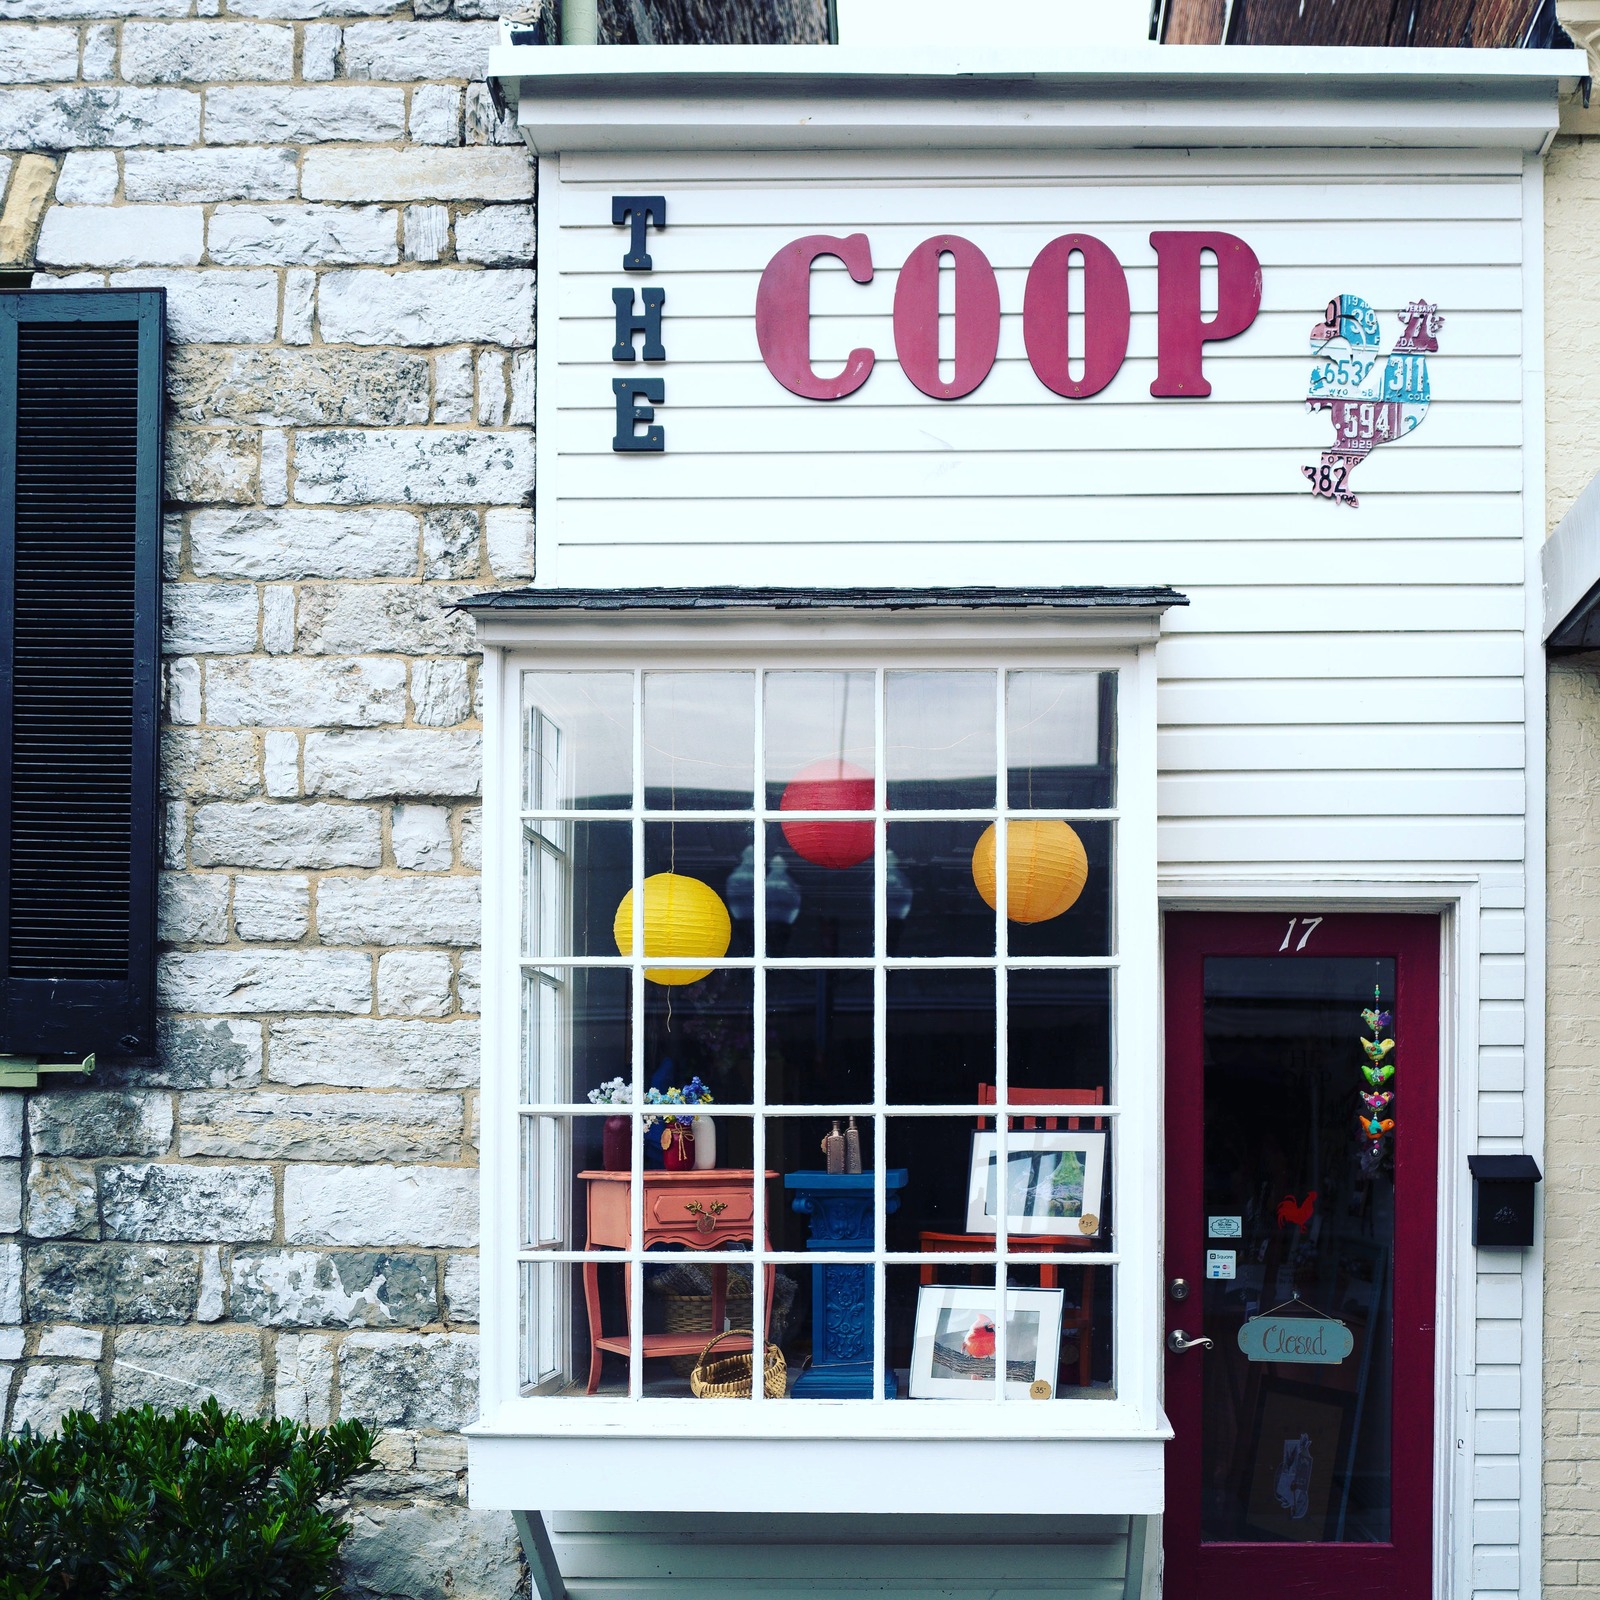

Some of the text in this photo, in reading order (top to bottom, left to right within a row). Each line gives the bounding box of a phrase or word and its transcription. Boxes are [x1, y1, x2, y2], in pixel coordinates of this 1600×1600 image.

[612, 196, 667, 453] THE
[756, 231, 1264, 401] COOP
[1389, 356, 1425, 392] 311
[1343, 402, 1390, 438] 594
[1347, 440, 1373, 449] 1929
[1304, 465, 1347, 492] 382
[1279, 916, 1323, 952] 17
[1262, 1325, 1327, 1355] Closed
